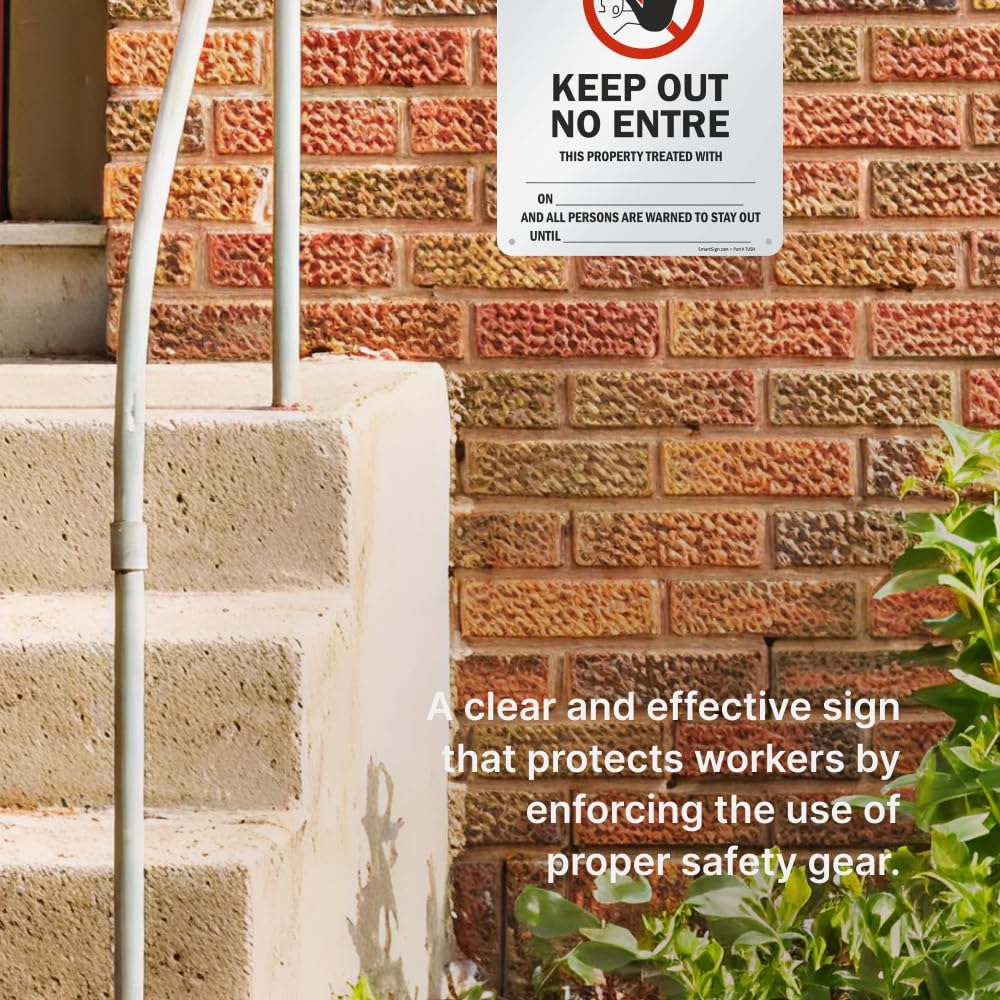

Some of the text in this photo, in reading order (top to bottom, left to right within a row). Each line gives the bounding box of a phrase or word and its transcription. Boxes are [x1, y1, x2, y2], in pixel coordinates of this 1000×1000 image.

[552, 73, 729, 102] KEEP OUT
[551, 109, 730, 138] NO ENTRE
[559, 150, 723, 162] THIS PROPERTY TREATED WITH
[537, 193, 553, 205] ON
[520, 211, 762, 223] AND ALL PERSONS ARE WARNED TO STAY OUT
[529, 230, 562, 242] UNTIL
